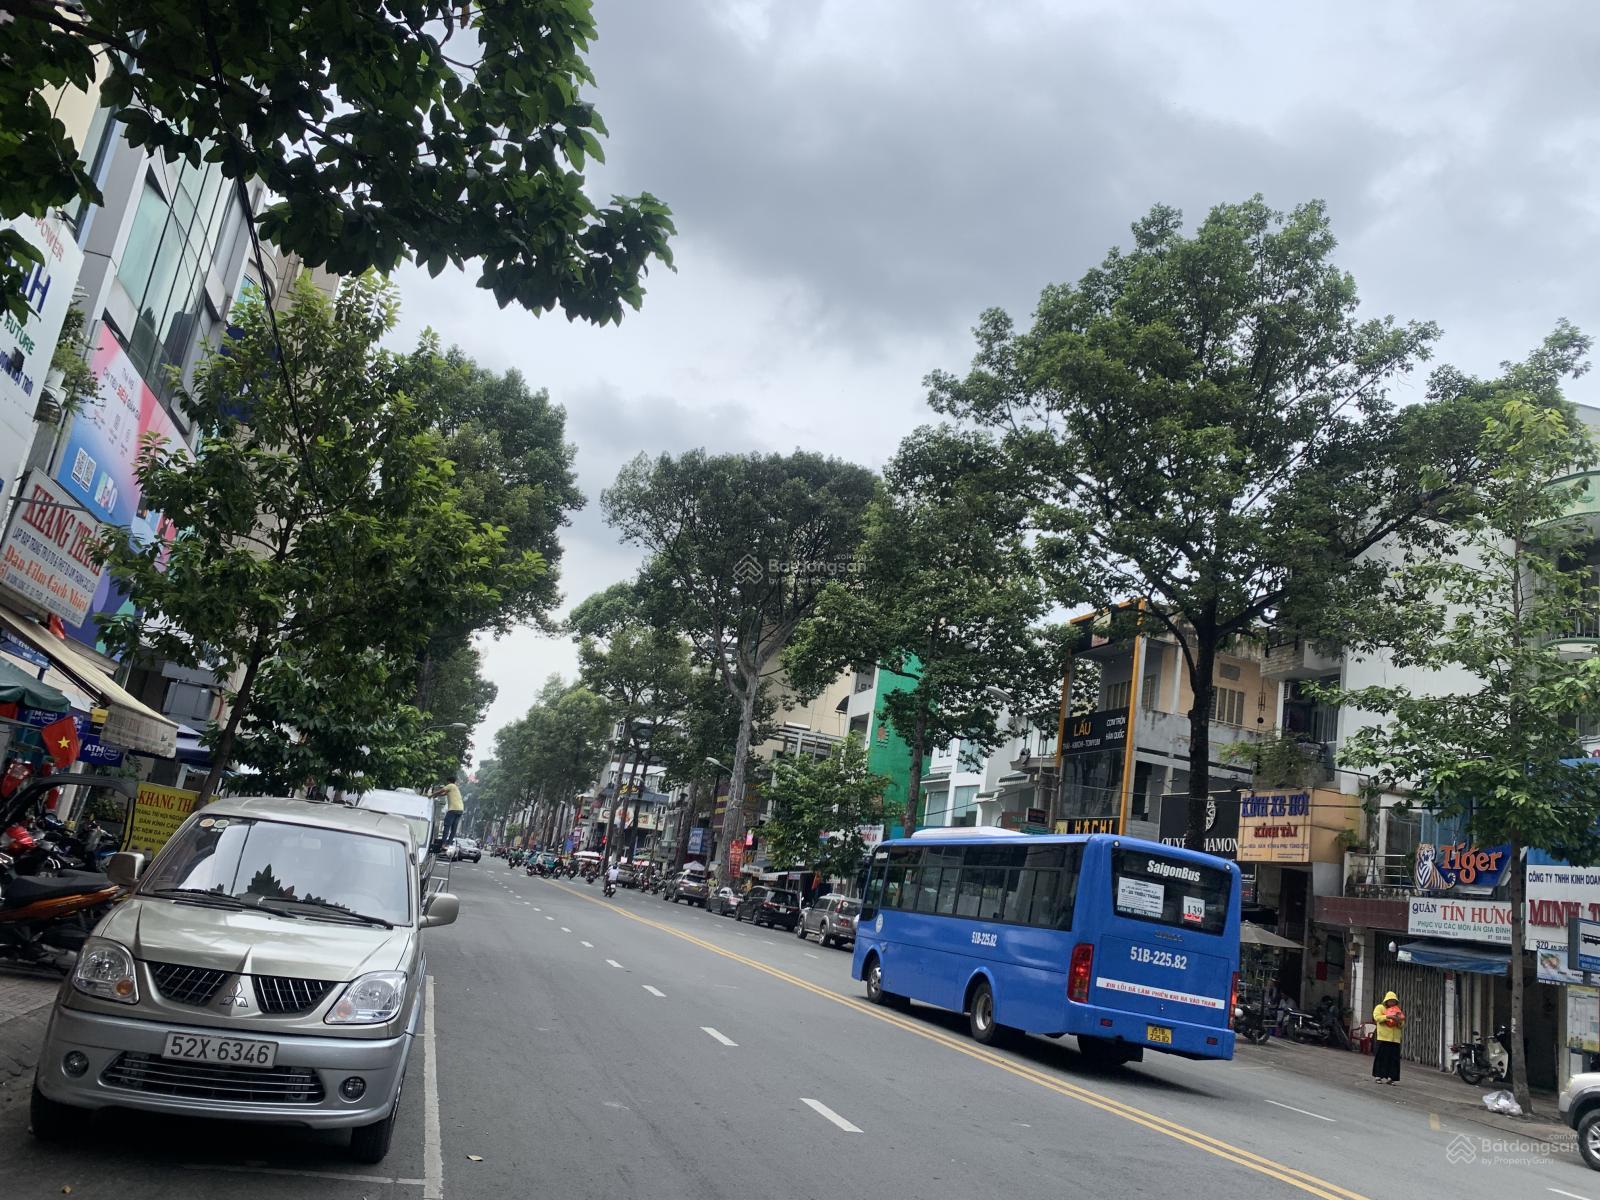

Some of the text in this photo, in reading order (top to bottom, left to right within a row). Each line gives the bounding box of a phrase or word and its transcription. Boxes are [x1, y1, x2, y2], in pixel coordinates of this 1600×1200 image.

[4, 314, 35, 356] FUTURE
[22, 484, 76, 549] KHANG
[84, 743, 105, 754] ATM
[136, 790, 193, 813] KHANG TH
[1147, 859, 1201, 882] SaigonBus
[1439, 842, 1503, 884] Tiger
[1528, 870, 1544, 883] CÔNG
[1545, 873, 1553, 883] TY
[1554, 873, 1570, 884] TNHH
[1570, 874, 1585, 885] KINH
[1187, 904, 1202, 916] 139
[1412, 901, 1437, 915] QUÁN
[1440, 901, 1466, 922] TÍN
[1529, 898, 1581, 927] MINH
[971, 931, 998, 947] 51B-225.82
[1483, 925, 1494, 933] GIA
[1536, 940, 1549, 950] 370
[1130, 946, 1188, 970] 51B-225.82
[1105, 981, 1116, 989] XIN
